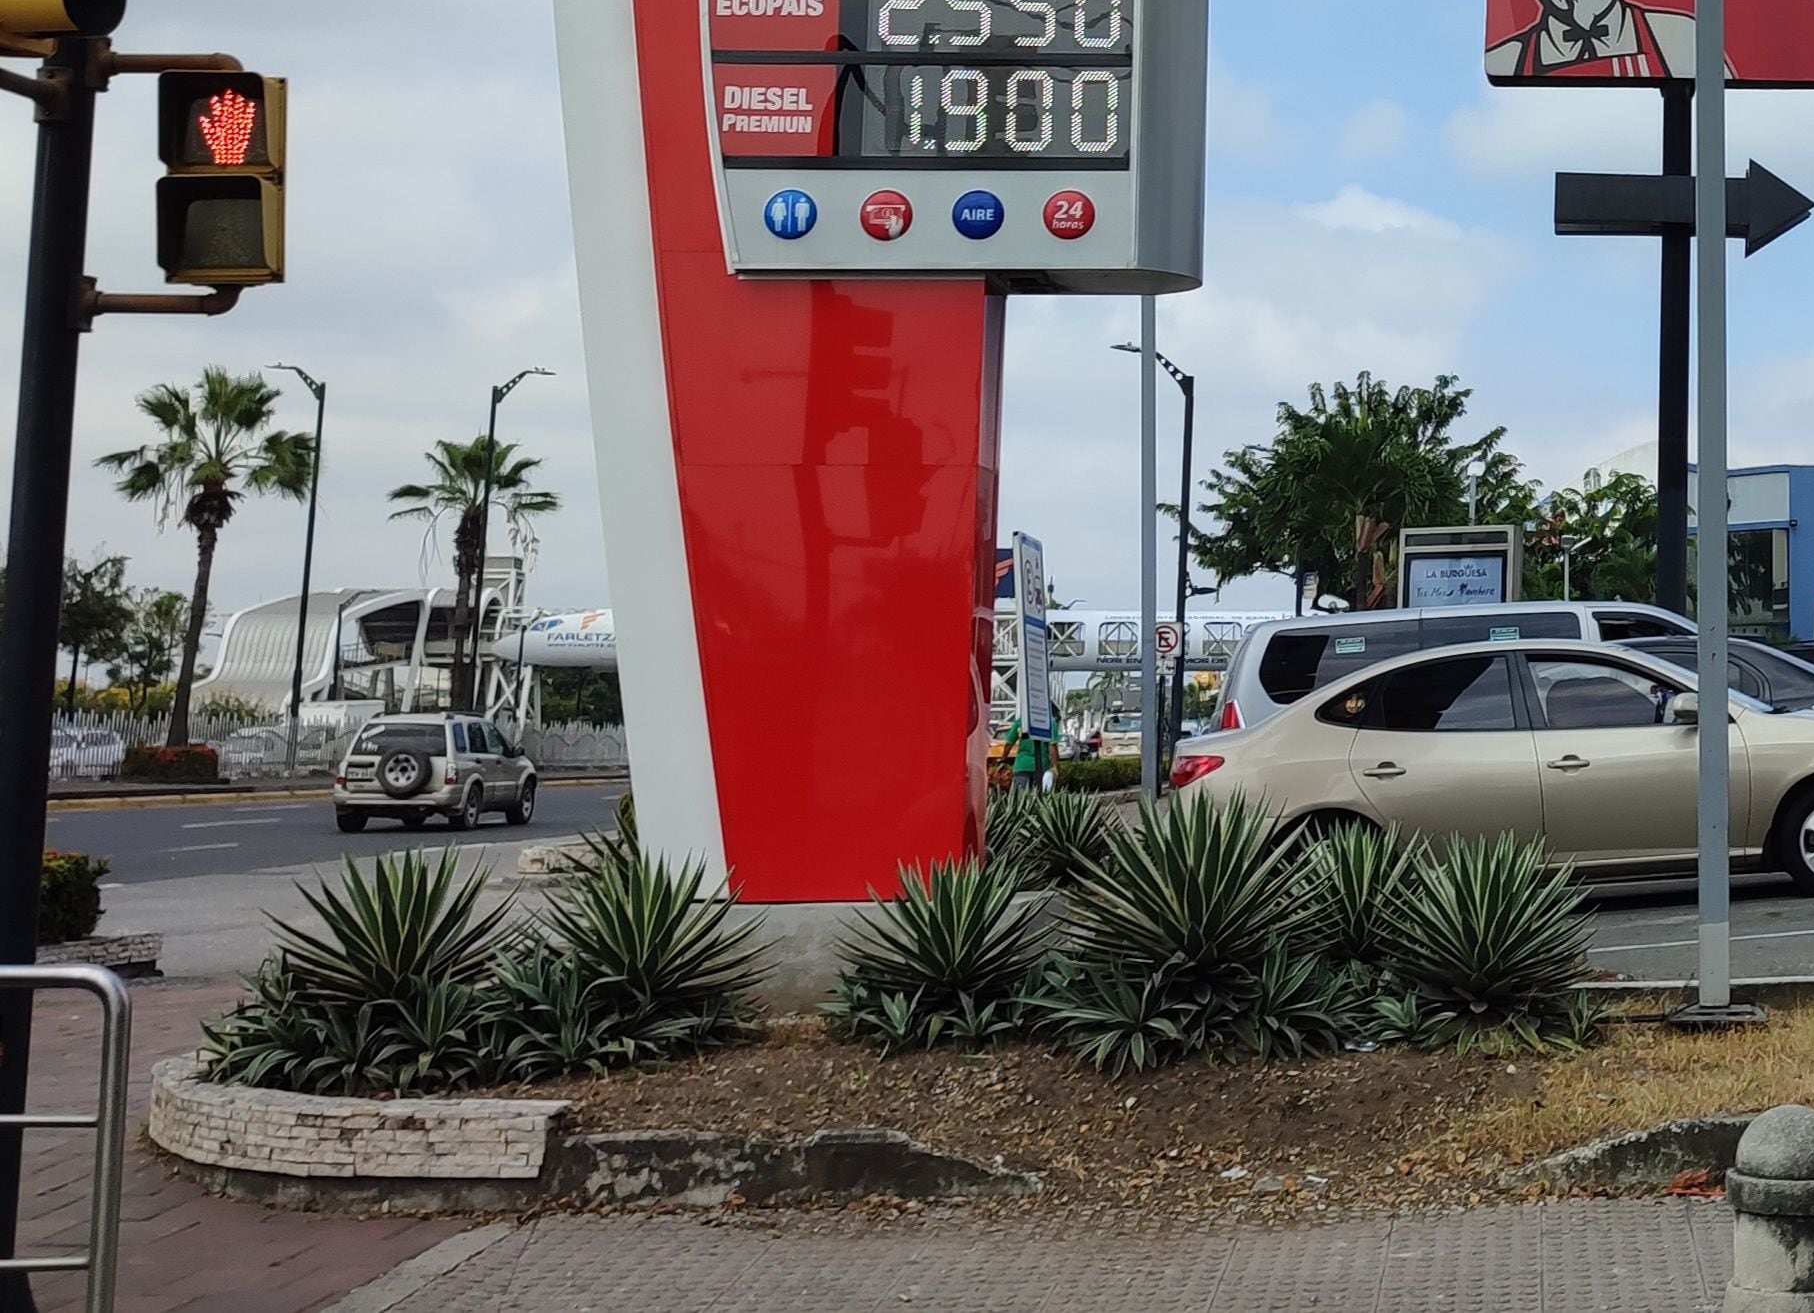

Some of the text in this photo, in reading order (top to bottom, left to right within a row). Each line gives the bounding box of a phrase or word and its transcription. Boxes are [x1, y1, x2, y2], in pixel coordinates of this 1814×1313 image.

[723, 69, 1120, 153] DIESEL 1.900
[960, 208, 996, 222] AIRE
[1054, 200, 1084, 219] 24
[1052, 218, 1085, 230] horas
[1426, 570, 1437, 579] LA
[547, 632, 616, 642] FARLETZ
